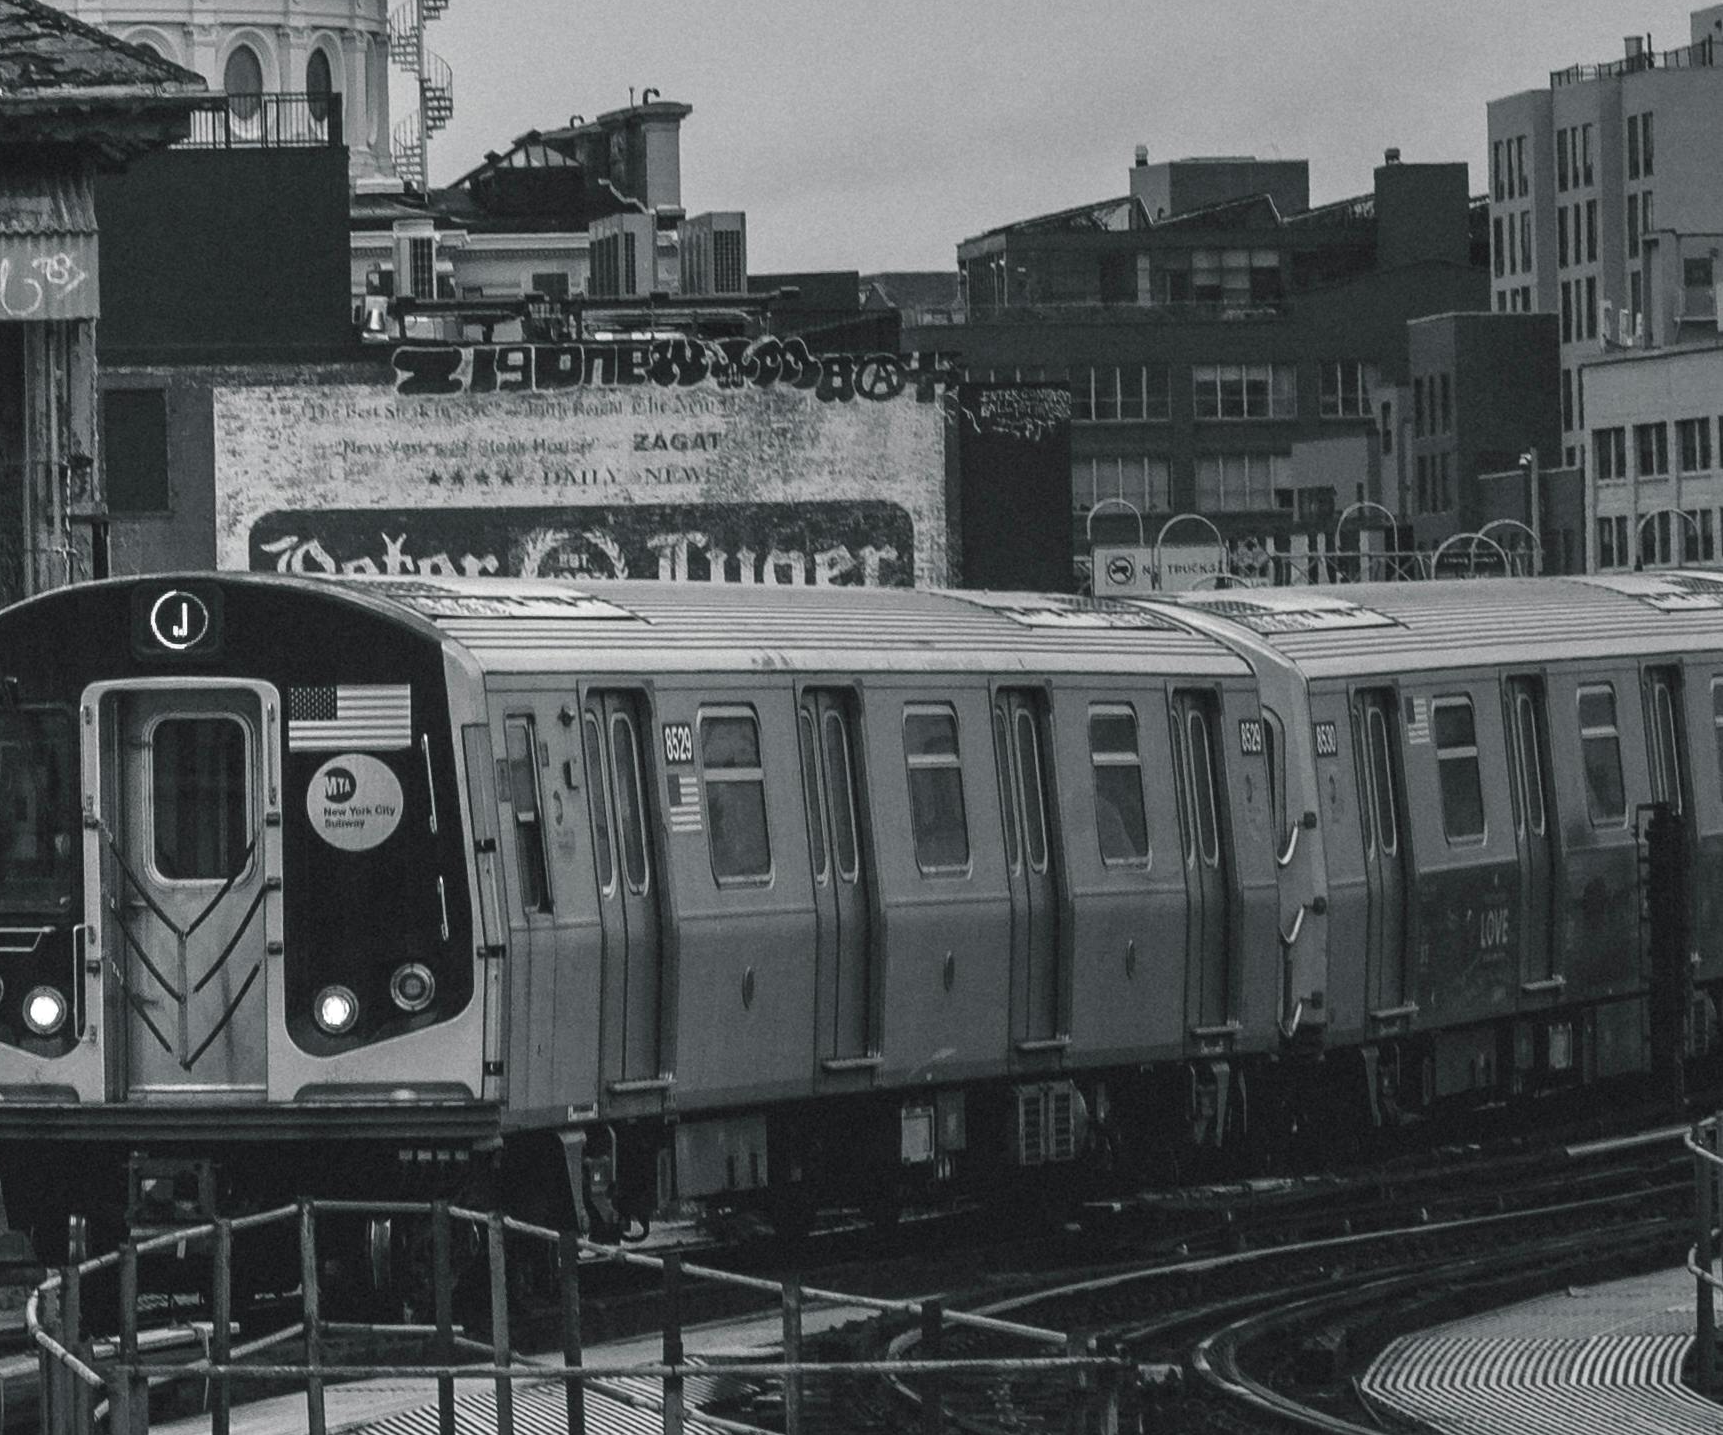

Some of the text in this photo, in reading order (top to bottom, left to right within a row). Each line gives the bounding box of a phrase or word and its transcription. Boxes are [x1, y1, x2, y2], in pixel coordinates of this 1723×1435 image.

[632, 433, 722, 452] ZAGAT
[172, 602, 188, 638] J
[664, 725, 692, 761] 8529
[1240, 722, 1262, 752] 8529
[1316, 724, 1337, 754] 8530
[323, 775, 351, 796] MTA
[323, 804, 396, 817] New York City
[324, 819, 366, 829] Subway
[1480, 908, 1509, 948] LOVE
